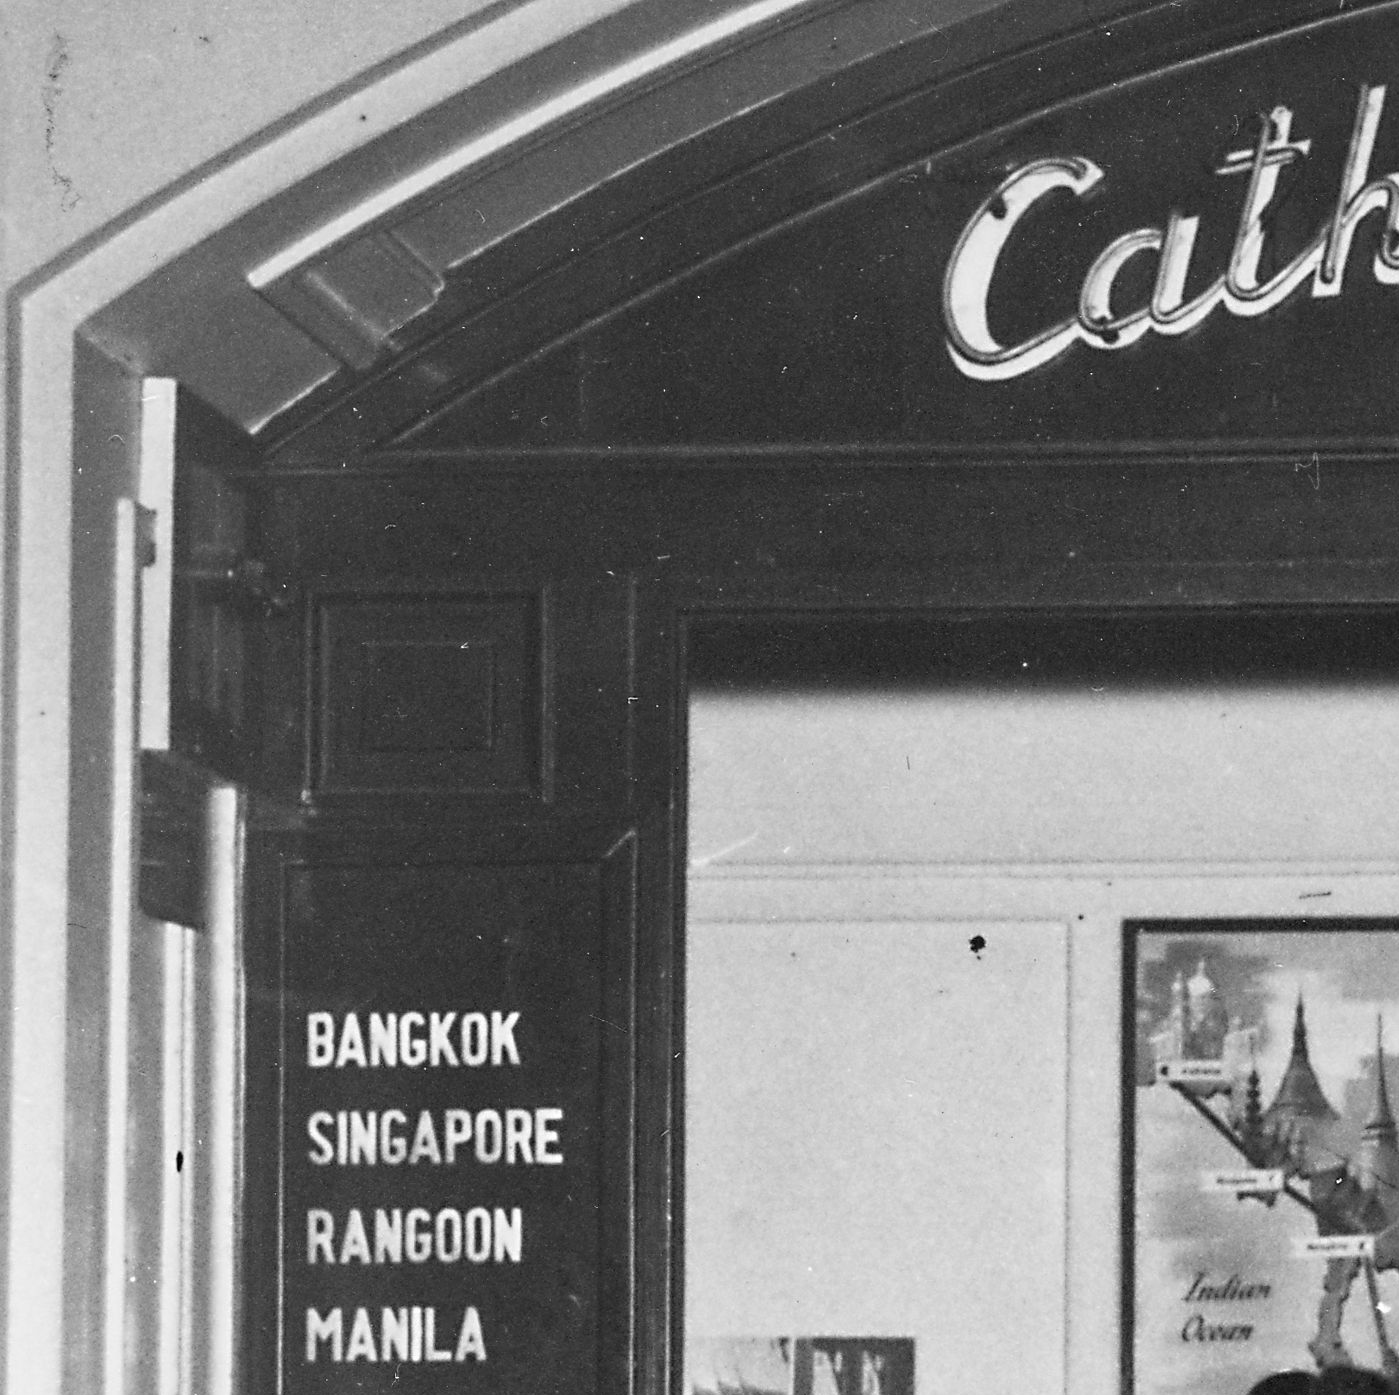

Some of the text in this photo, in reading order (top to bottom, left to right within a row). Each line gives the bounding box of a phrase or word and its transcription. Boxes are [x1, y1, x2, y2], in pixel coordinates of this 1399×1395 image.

[307, 1011, 520, 1068] BANGKOK
[307, 1108, 564, 1165] SINGAPORE
[307, 1207, 522, 1265] RANGOON
[1181, 1271, 1271, 1302] Indian
[306, 1306, 487, 1363] MANILA
[1181, 1312, 1254, 1343] Ocean
